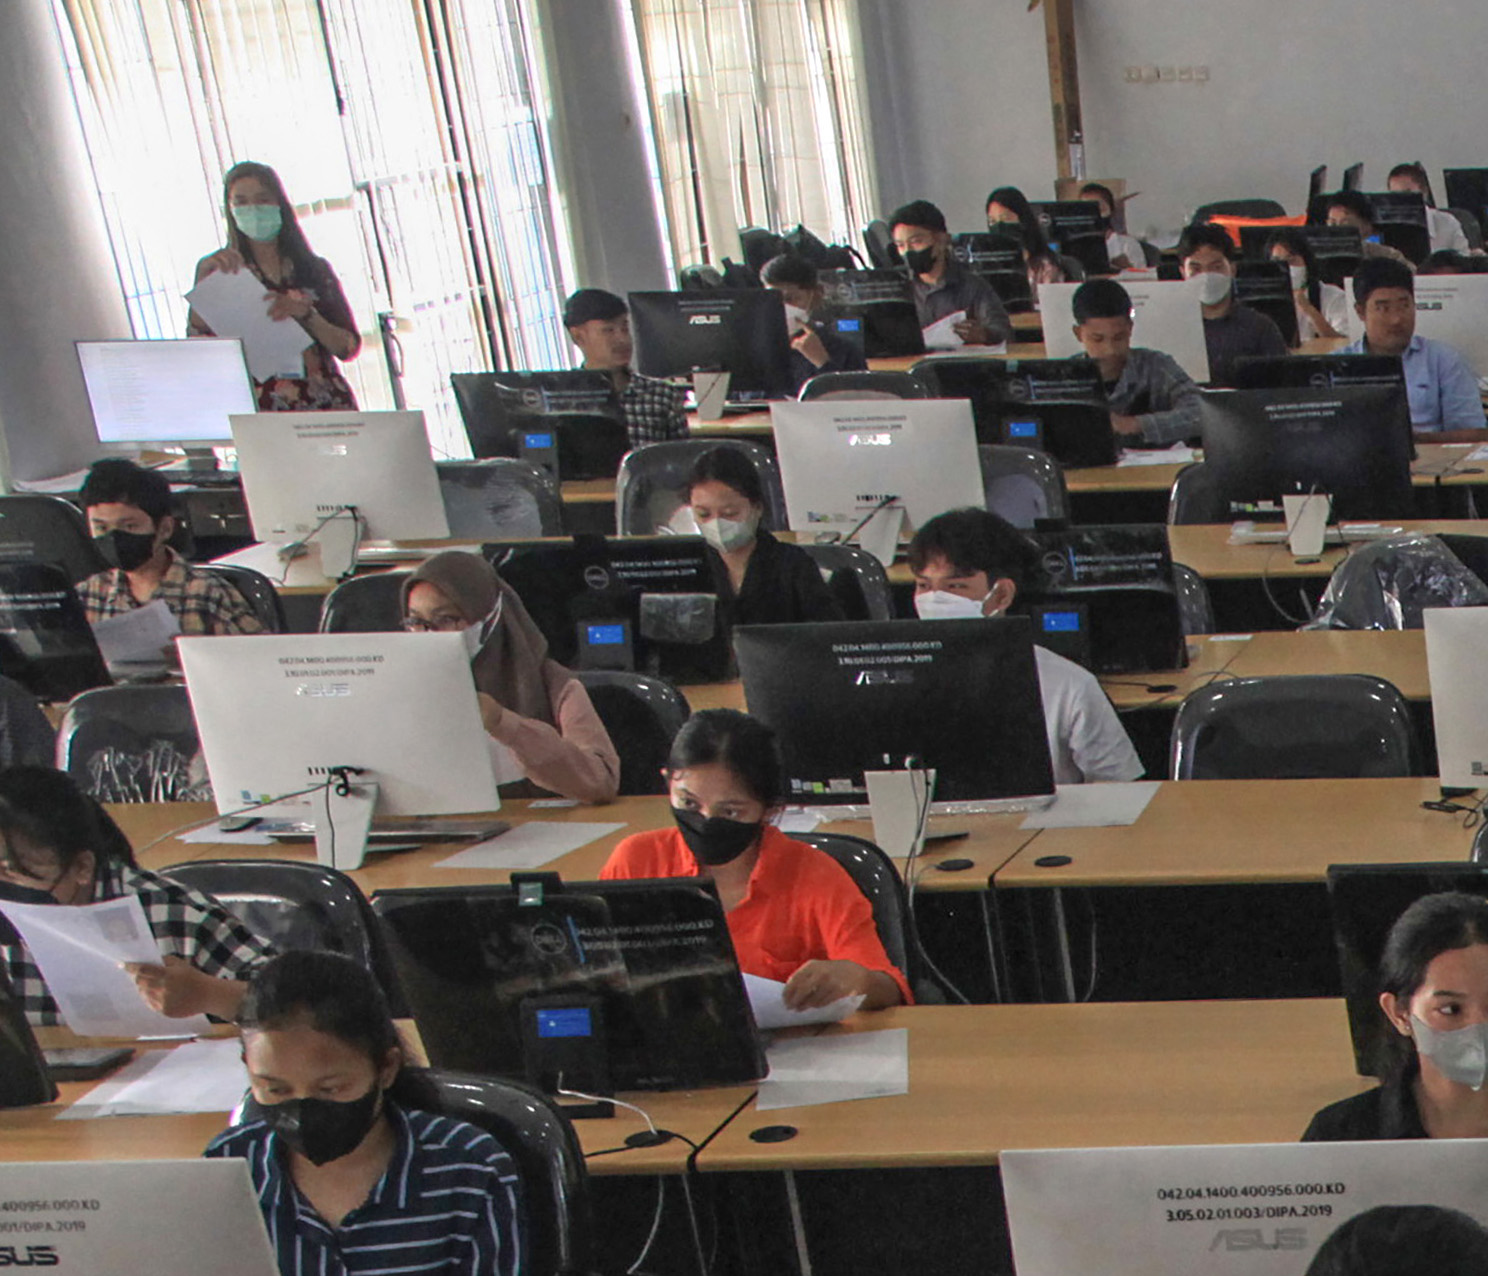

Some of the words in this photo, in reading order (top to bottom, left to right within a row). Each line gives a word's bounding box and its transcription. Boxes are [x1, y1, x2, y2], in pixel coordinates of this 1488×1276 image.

[1157, 1183, 1346, 1201] 042.04.1400.400956.000.KD
[1166, 1205, 1334, 1222] 3.05.02.01.003/DIPA.2019
[1209, 1227, 1308, 1252] ASUS
